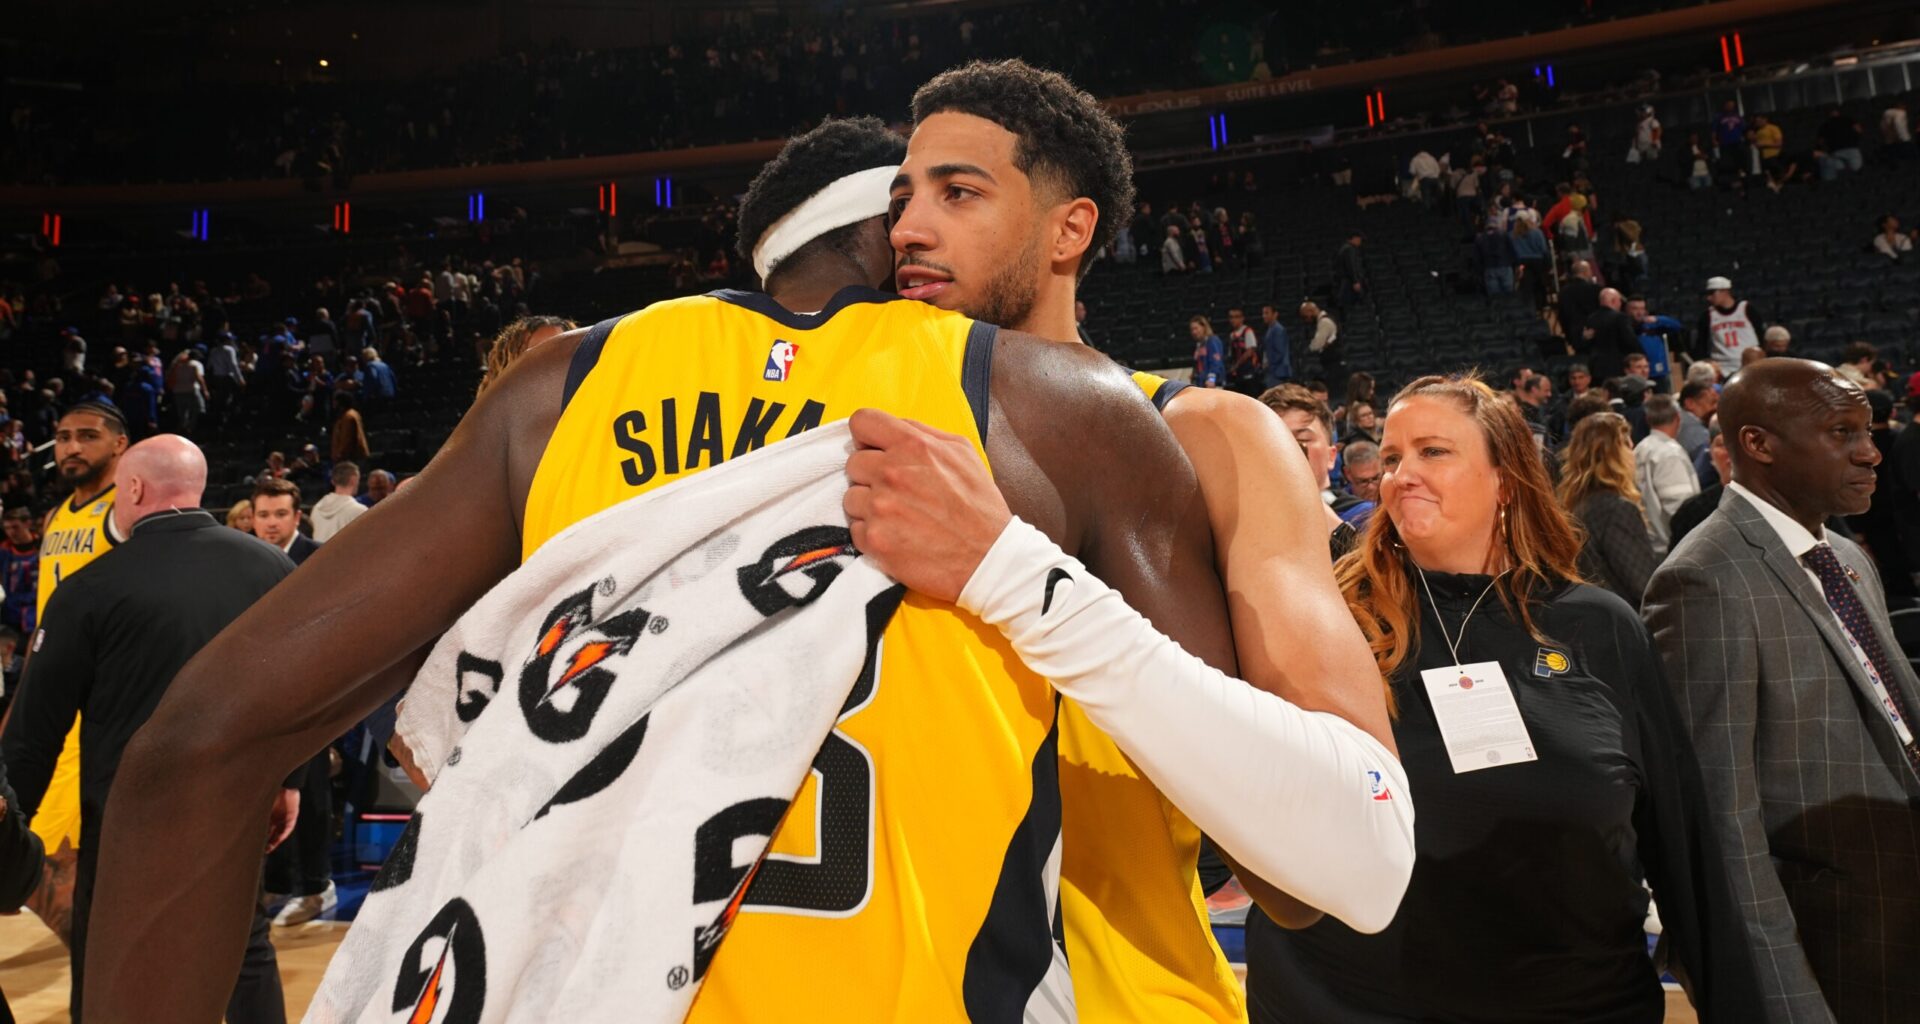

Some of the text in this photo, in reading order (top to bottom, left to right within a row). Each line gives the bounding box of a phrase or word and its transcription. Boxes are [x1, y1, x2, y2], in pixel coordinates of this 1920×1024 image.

[1225, 79, 1314, 102] SUITE LEVEL
[1724, 331, 1739, 348] 11
[765, 369, 780, 379] NBA
[40, 527, 96, 559] DIANA
